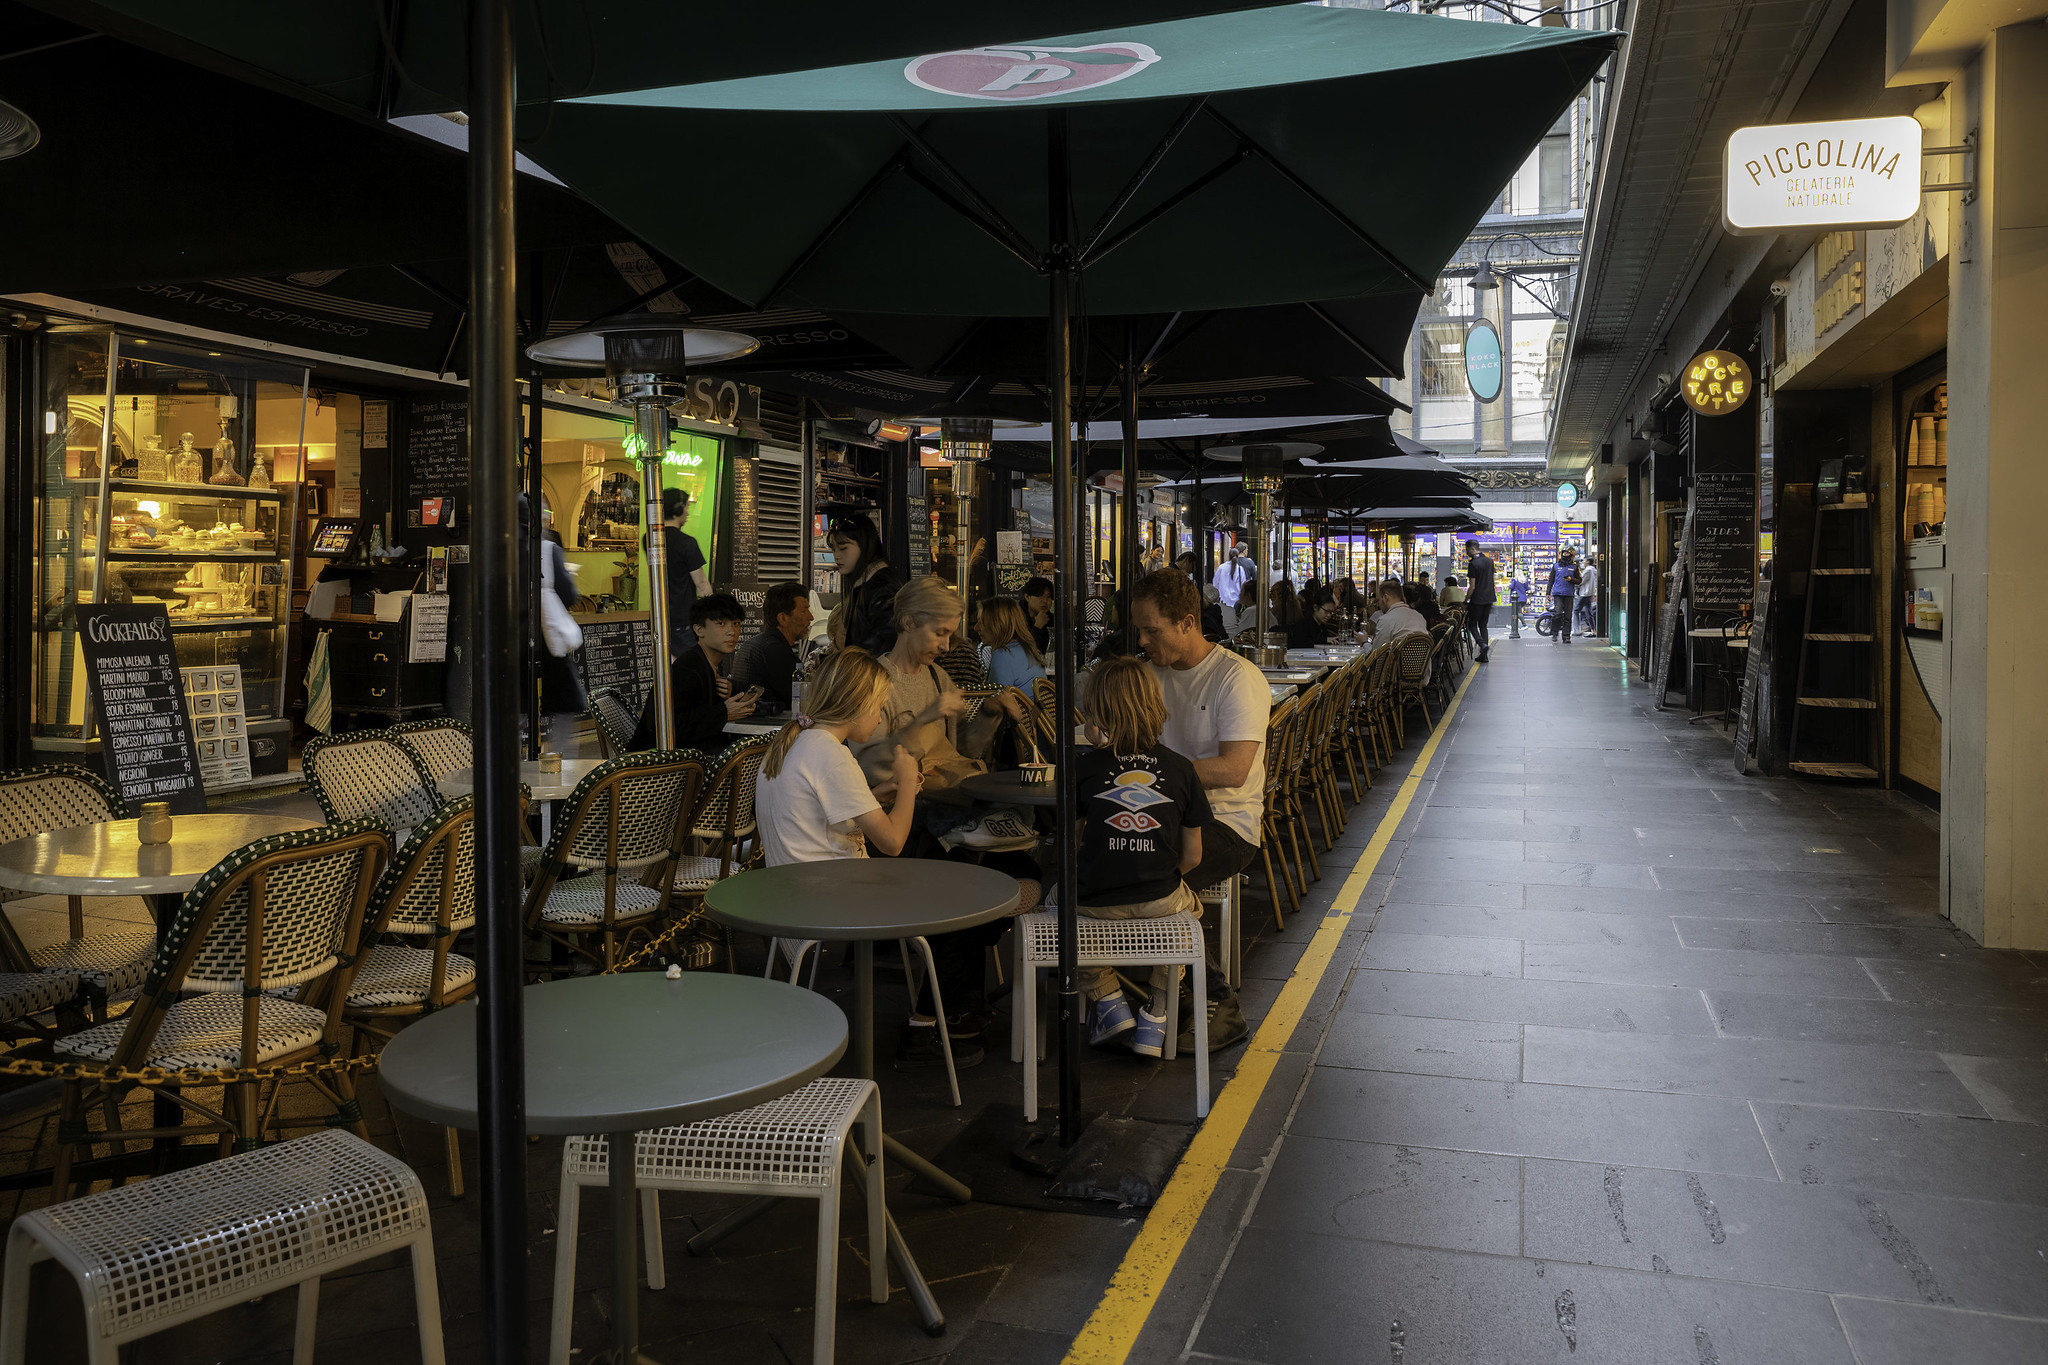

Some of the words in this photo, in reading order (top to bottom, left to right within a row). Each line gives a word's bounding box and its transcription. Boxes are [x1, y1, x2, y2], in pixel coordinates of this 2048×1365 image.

[1745, 139, 1900, 186] PICCOLINA
[1786, 175, 1855, 192] GELATERIA
[1787, 192, 1853, 208] NATURALE
[247, 305, 369, 337] ESPRESSO
[757, 329, 848, 346] RESSO
[1471, 353, 1496, 361] KOKO
[1469, 361, 1499, 371] BLACK
[1691, 356, 1742, 381] MOCK
[1705, 527, 1740, 536] SIDES
[88, 614, 161, 643] COCKTAILS
[97, 656, 123, 669] MIMOSA
[100, 672, 126, 686] MARTINI
[126, 671, 150, 683] MADRID
[103, 687, 127, 701] BLOODY
[127, 686, 147, 698] MARIA
[169, 685, 176, 696] 16
[105, 703, 125, 717] SOUR
[110, 718, 145, 733] MANHATTAN
[174, 714, 183, 727] 20
[112, 735, 143, 750] ESPRESSO
[142, 733, 166, 747] MARTINI
[178, 730, 186, 743] 19
[116, 752, 139, 766] MOJITO
[140, 749, 164, 762] GINGER
[119, 767, 148, 782] NEGRONI
[184, 761, 192, 773] 19
[153, 778, 188, 794] MARGARITA
[1109, 837, 1127, 851] RIP
[1129, 838, 1156, 852] CURL
